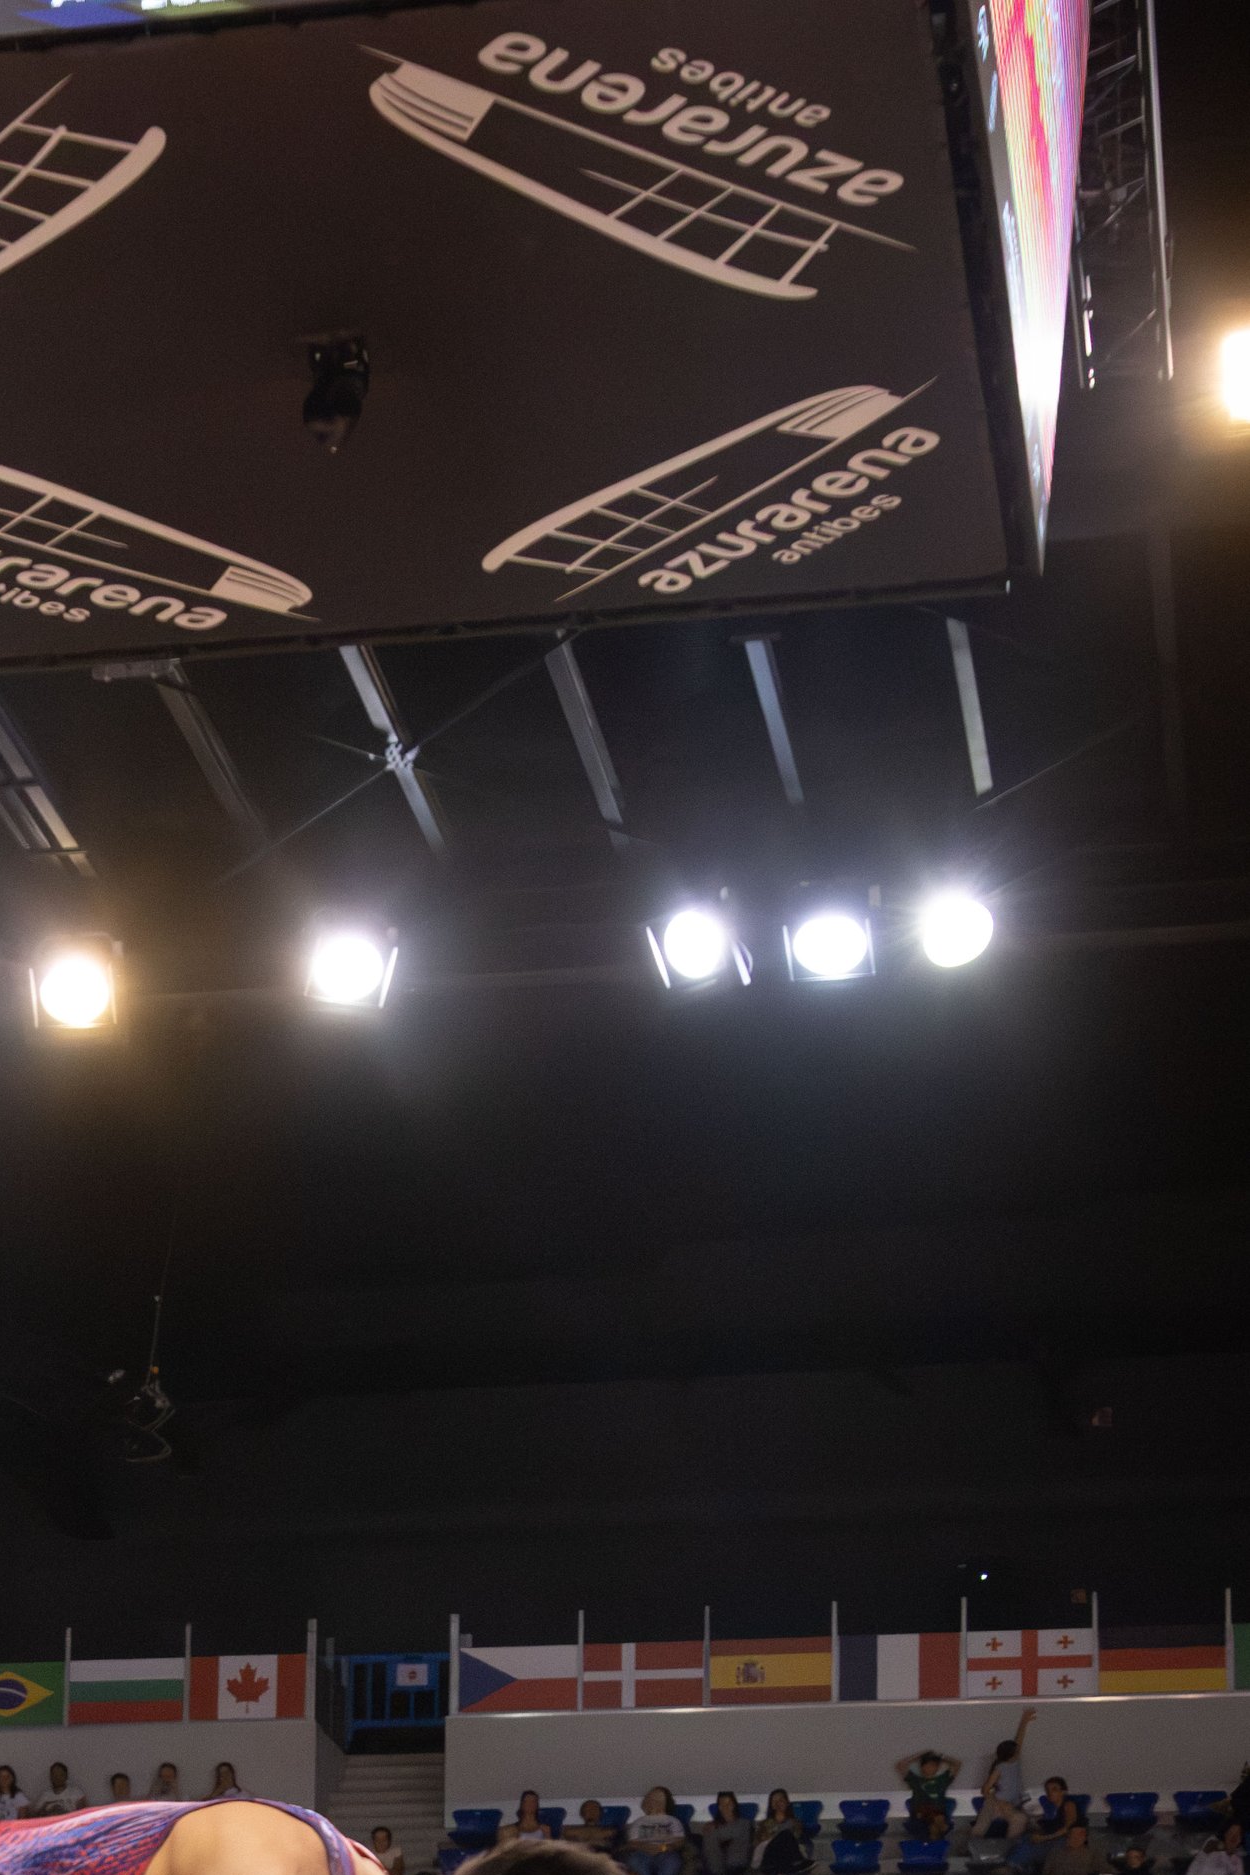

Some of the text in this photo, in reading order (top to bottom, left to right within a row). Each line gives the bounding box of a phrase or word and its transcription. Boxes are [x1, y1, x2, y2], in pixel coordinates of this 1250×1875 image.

[477, 31, 903, 205] azurarena
[651, 46, 831, 126] antibes
[637, 424, 940, 594] azurarena
[771, 493, 903, 565] antibes
